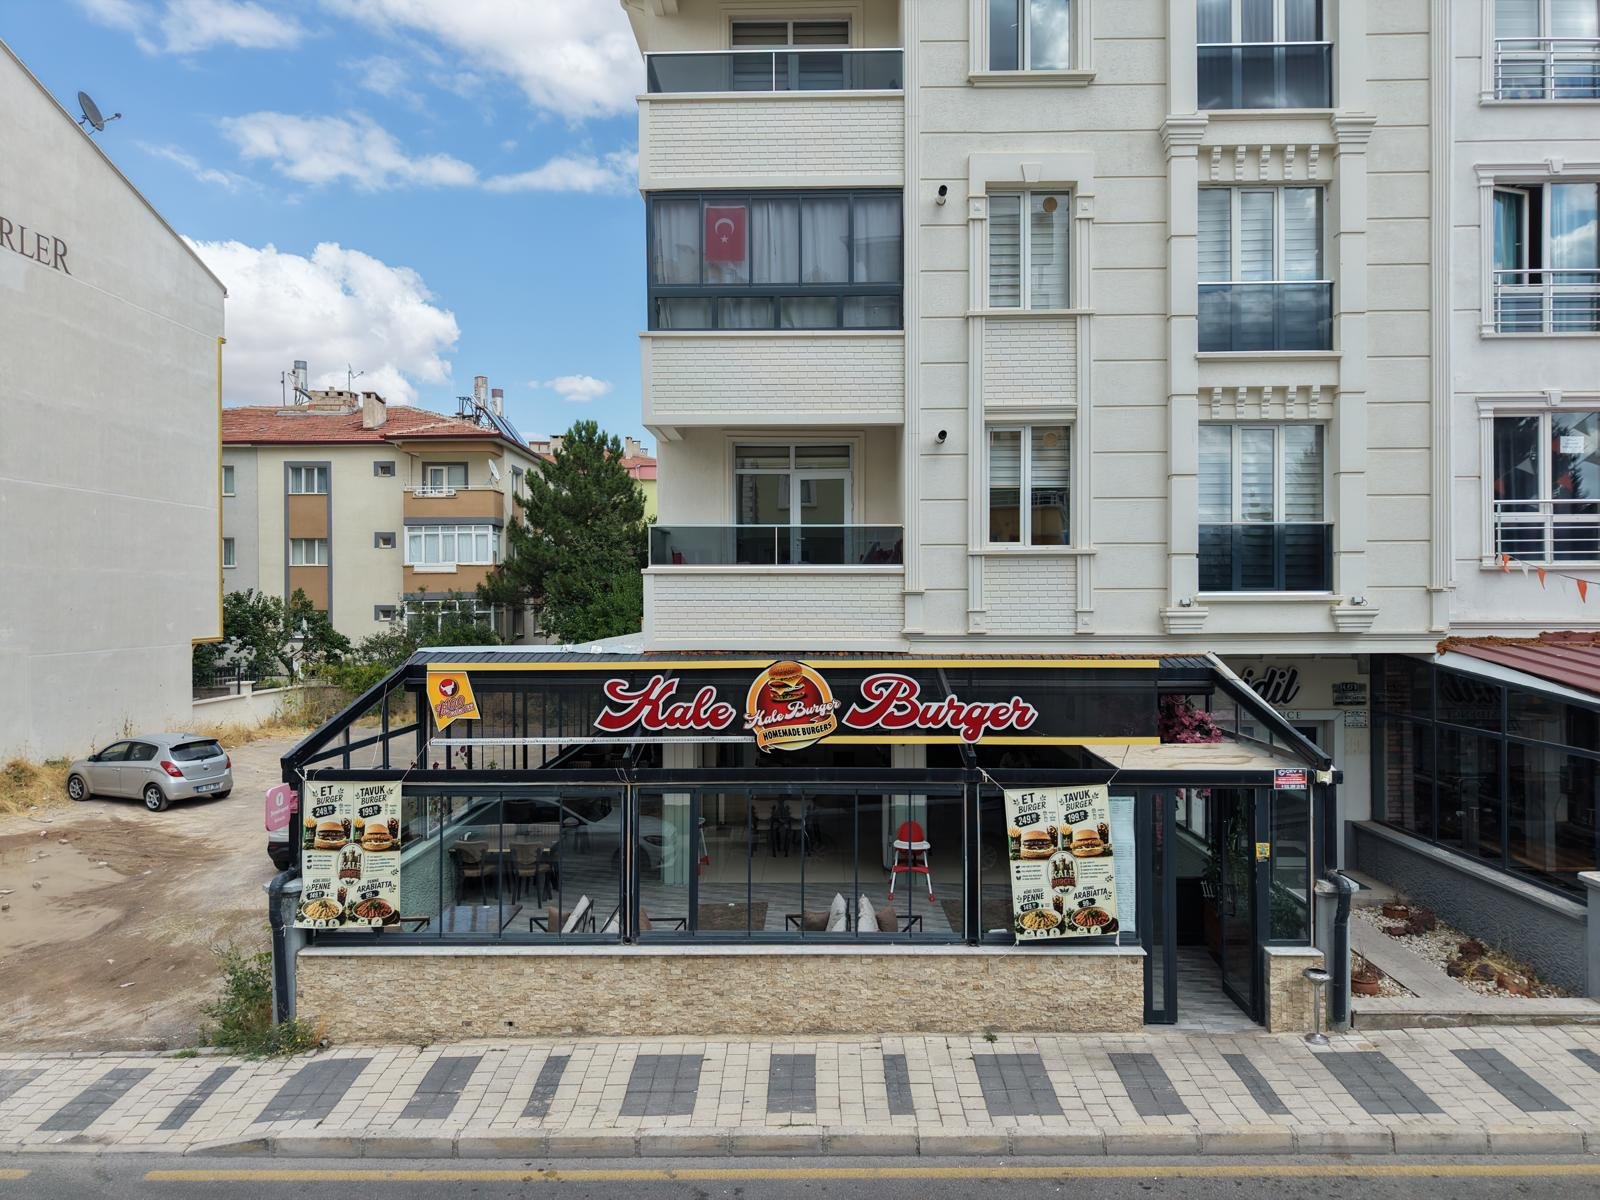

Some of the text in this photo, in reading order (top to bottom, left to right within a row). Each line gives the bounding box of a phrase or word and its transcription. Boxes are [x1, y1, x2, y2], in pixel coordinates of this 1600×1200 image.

[0, 216, 72, 275] RLER
[593, 672, 1039, 744] Kale Burger
[743, 698, 841, 729] Kale Burger
[763, 722, 832, 741] HOMEMADE BURGERS
[320, 785, 334, 796] ET
[360, 785, 386, 797] TAVUK
[1064, 789, 1091, 803] TAVUK
[316, 794, 343, 805] BURGER
[361, 794, 387, 805] BURGER
[1021, 793, 1035, 804] ET
[1018, 801, 1047, 814] BURGER
[1065, 799, 1093, 811] BURGER
[1053, 869, 1075, 879] KALE
[311, 882, 331, 891] PENNE
[357, 881, 393, 893] ARABIATTA
[1022, 892, 1045, 903] PENNE
[1073, 888, 1108, 900] ARABIATTA
